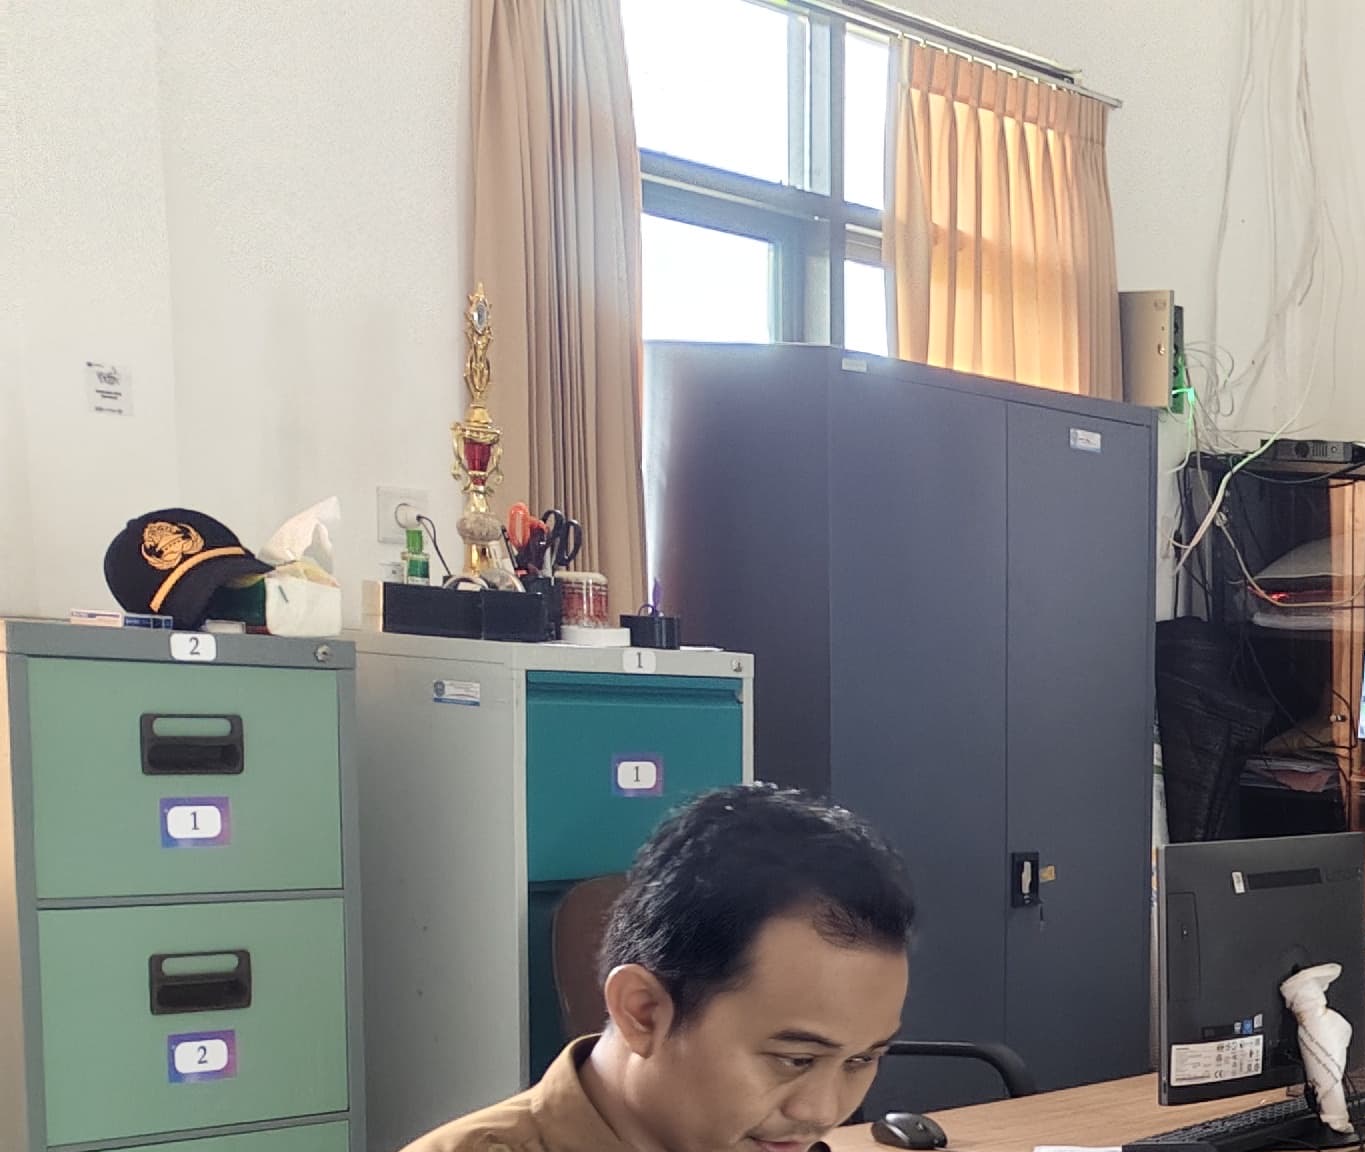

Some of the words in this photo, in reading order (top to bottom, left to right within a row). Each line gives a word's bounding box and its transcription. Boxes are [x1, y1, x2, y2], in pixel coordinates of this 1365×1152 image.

[189, 637, 200, 655] 2
[636, 652, 643, 668] 1
[633, 766, 640, 782] 1
[190, 812, 200, 831] 1
[197, 1046, 208, 1065] 2
